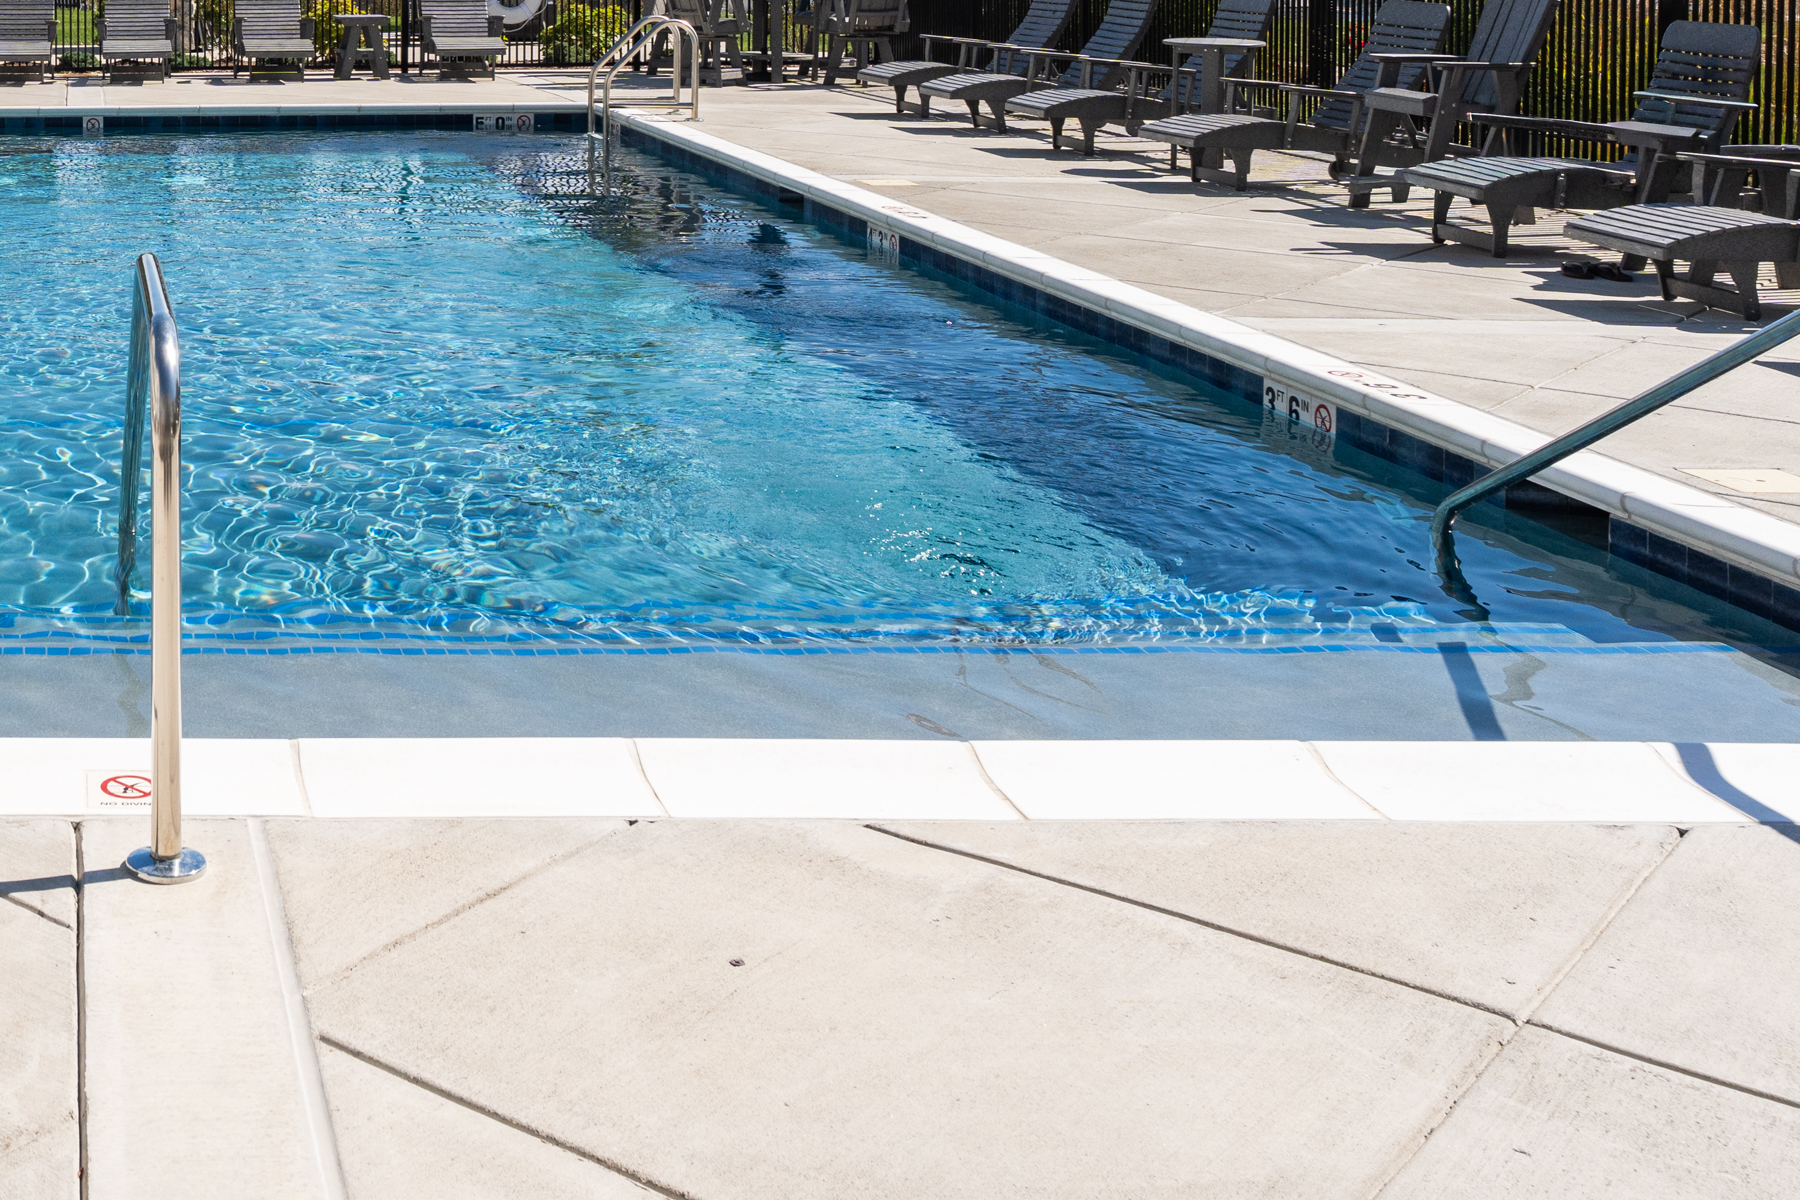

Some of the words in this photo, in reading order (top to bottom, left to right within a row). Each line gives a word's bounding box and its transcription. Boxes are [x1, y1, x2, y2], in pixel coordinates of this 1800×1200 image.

[1265, 386, 1276, 411] 3
[1276, 389, 1285, 403] FT
[1288, 395, 1300, 421] 6
[1300, 399, 1309, 413] IN
